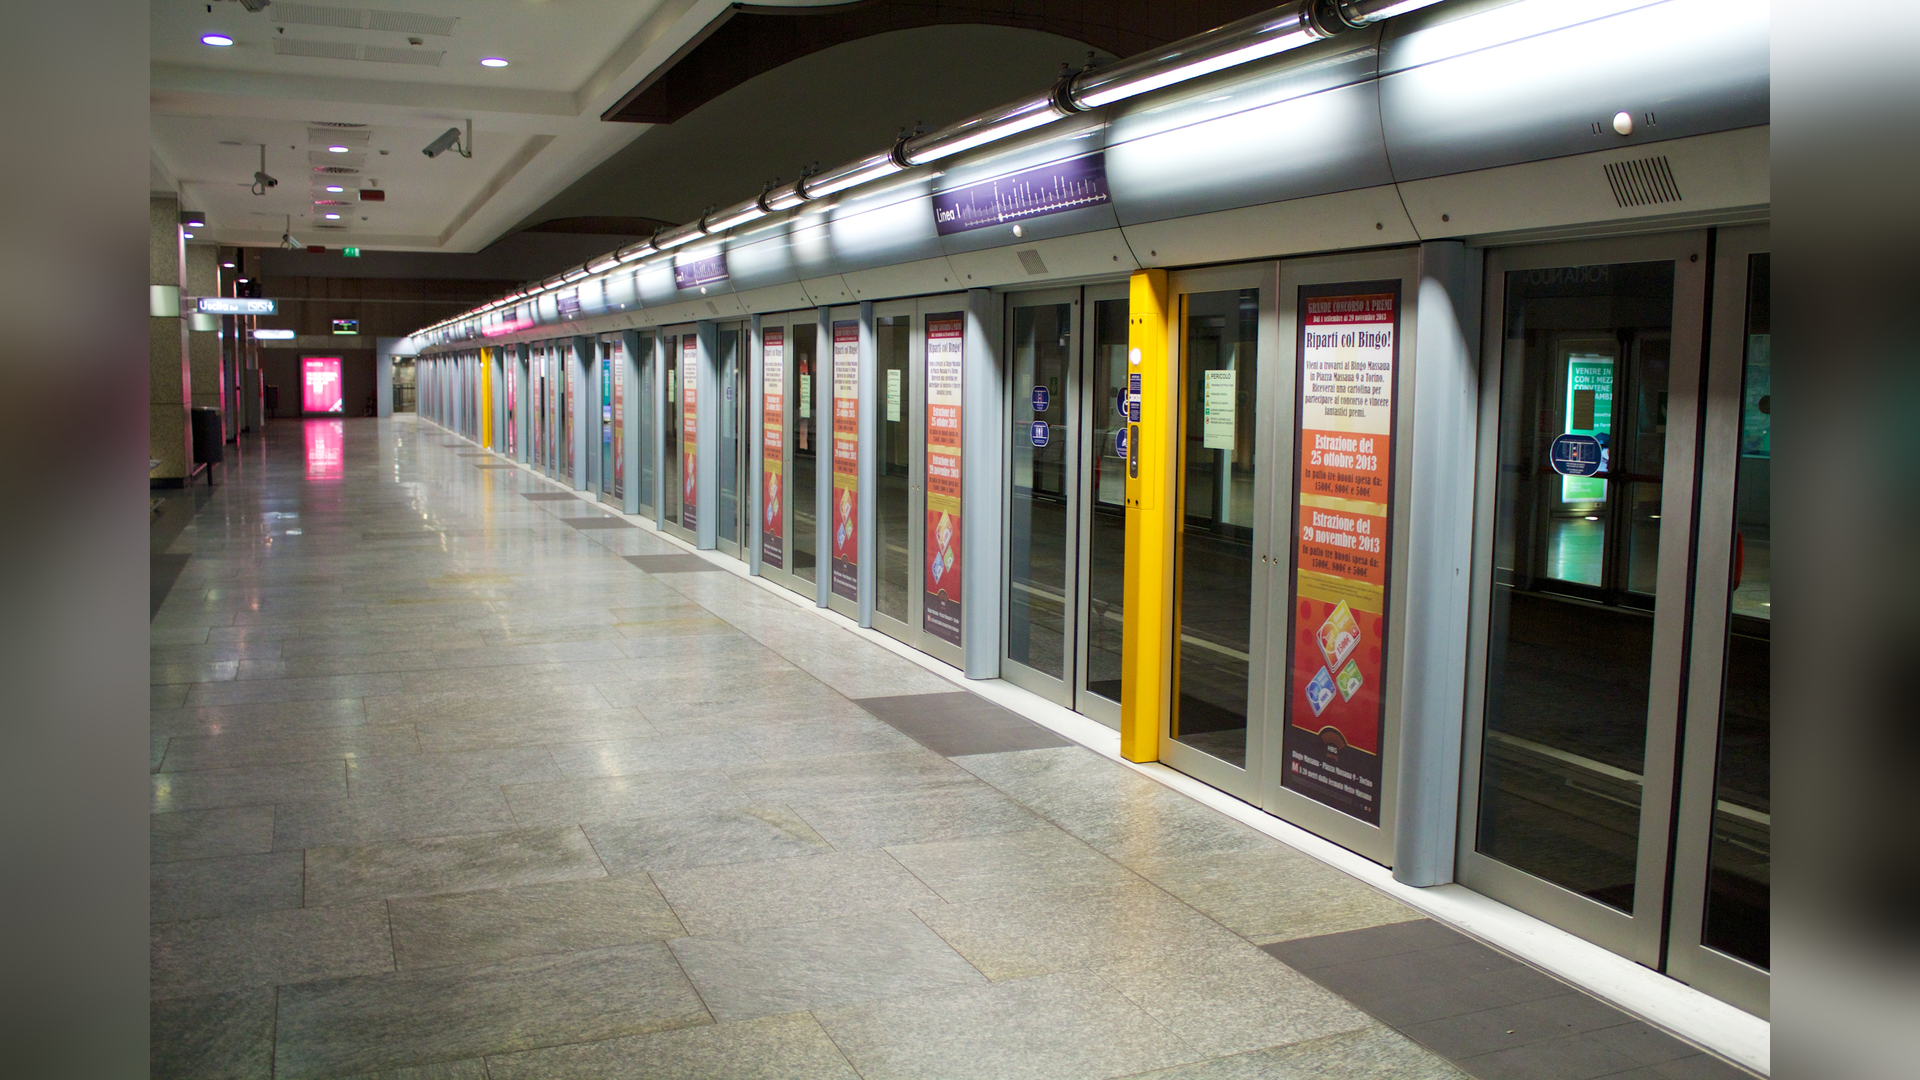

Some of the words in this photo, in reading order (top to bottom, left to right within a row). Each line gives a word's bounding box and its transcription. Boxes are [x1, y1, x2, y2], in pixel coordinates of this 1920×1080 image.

[936, 207, 955, 223] Linea
[955, 203, 961, 219] 1
[200, 300, 228, 311] Uscita
[1308, 302, 1331, 314] GRANDE
[1332, 300, 1364, 312] CONCORSO
[1365, 300, 1370, 311] A
[1372, 299, 1392, 311] PREMI
[1355, 314, 1376, 322] novembre
[1306, 332, 1338, 350] Riparti
[1342, 332, 1355, 347] col
[1358, 331, 1391, 350] Bingo!
[1351, 361, 1366, 371] Bingo
[1576, 367, 1601, 375] VENIRE
[1316, 372, 1332, 381] Piazza
[1356, 373, 1359, 382] 9
[1366, 373, 1384, 383] Torino.
[1372, 386, 1382, 395] per
[1315, 434, 1358, 452] Estrazione
[1359, 438, 1374, 454] del
[1310, 450, 1322, 465] 25
[1324, 452, 1354, 468] ottobre
[1356, 454, 1377, 471] 2013
[1306, 469, 1311, 478] In
[1338, 472, 1354, 483] buoni
[1355, 475, 1371, 485] spesa
[1373, 476, 1382, 486] da:
[1350, 487, 1354, 495] e
[1313, 511, 1354, 532] Estrazione
[1356, 518, 1370, 534] del
[1303, 526, 1314, 541] 29
[1316, 530, 1356, 549] novembre
[1358, 535, 1380, 553] 2013
[1303, 545, 1308, 554] In
[1335, 550, 1350, 562] buoni
[1352, 555, 1368, 566] spesa
[1370, 557, 1379, 567] da:
[1348, 566, 1351, 574] e
